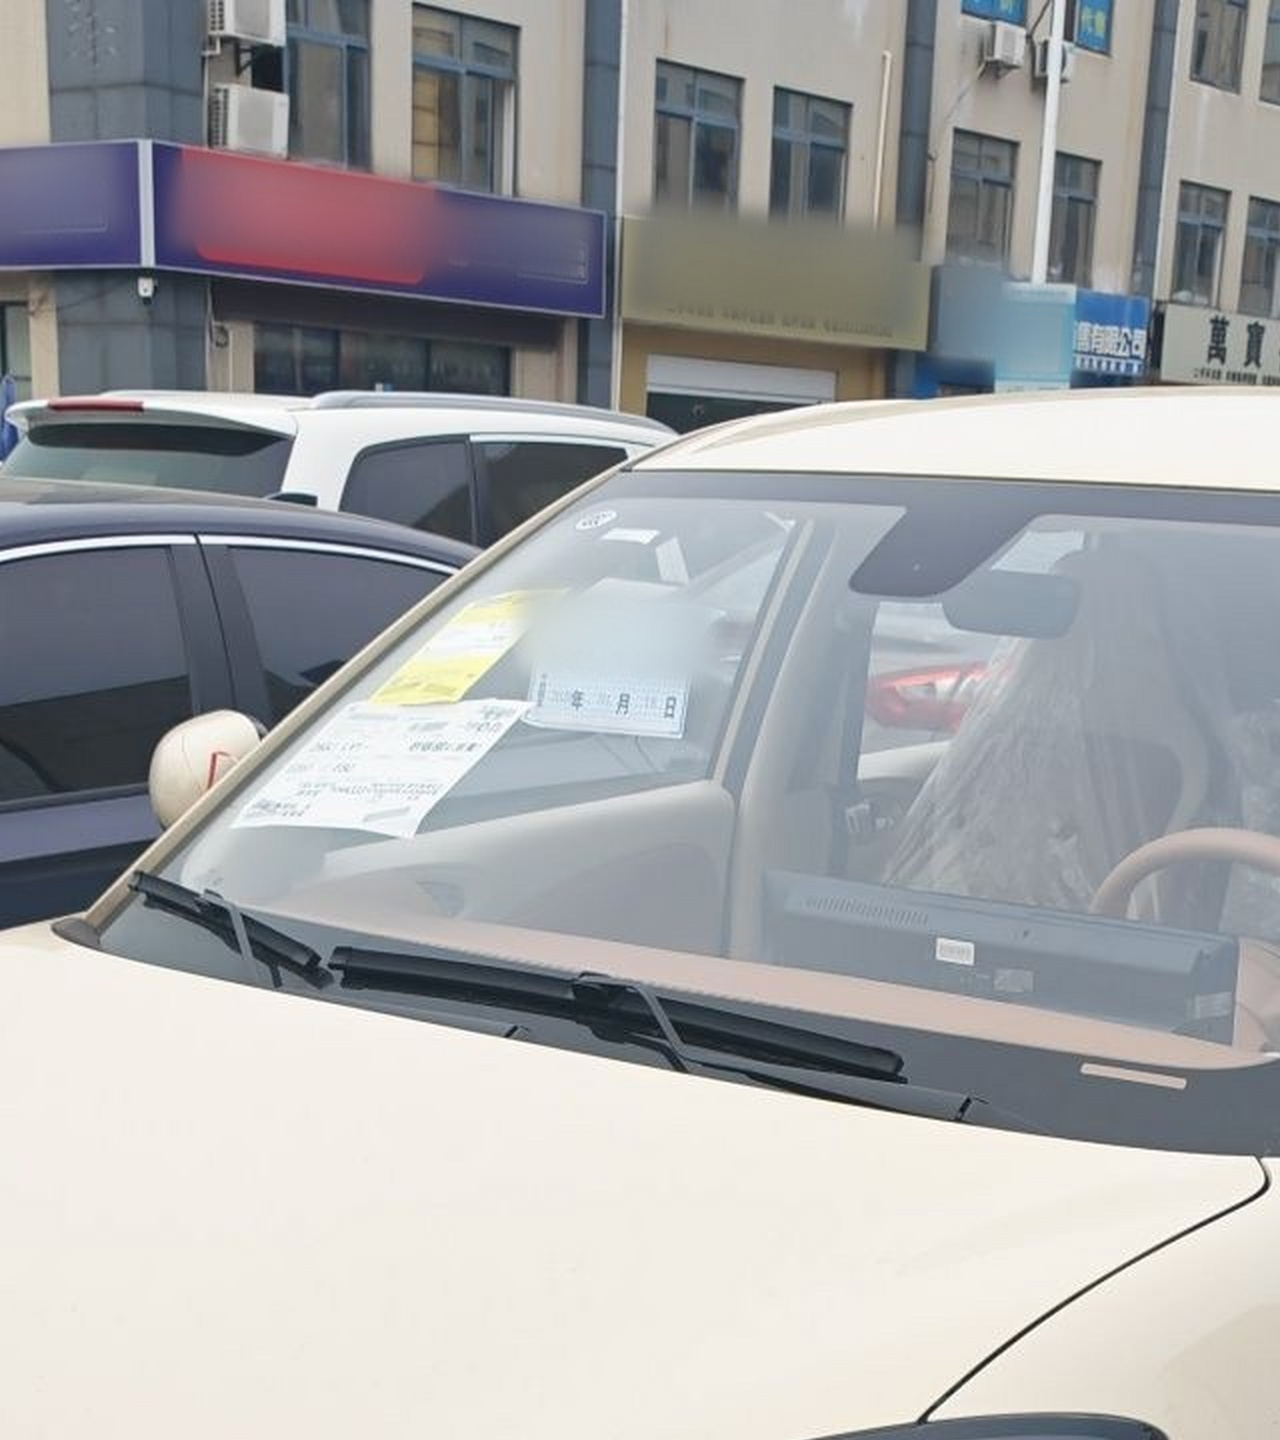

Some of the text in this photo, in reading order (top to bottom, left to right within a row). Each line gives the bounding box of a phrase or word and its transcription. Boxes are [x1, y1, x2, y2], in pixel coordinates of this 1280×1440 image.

[1074, 320, 1147, 359] 售有限公司
[615, 693, 631, 716] 月
[663, 695, 678, 719] 日
